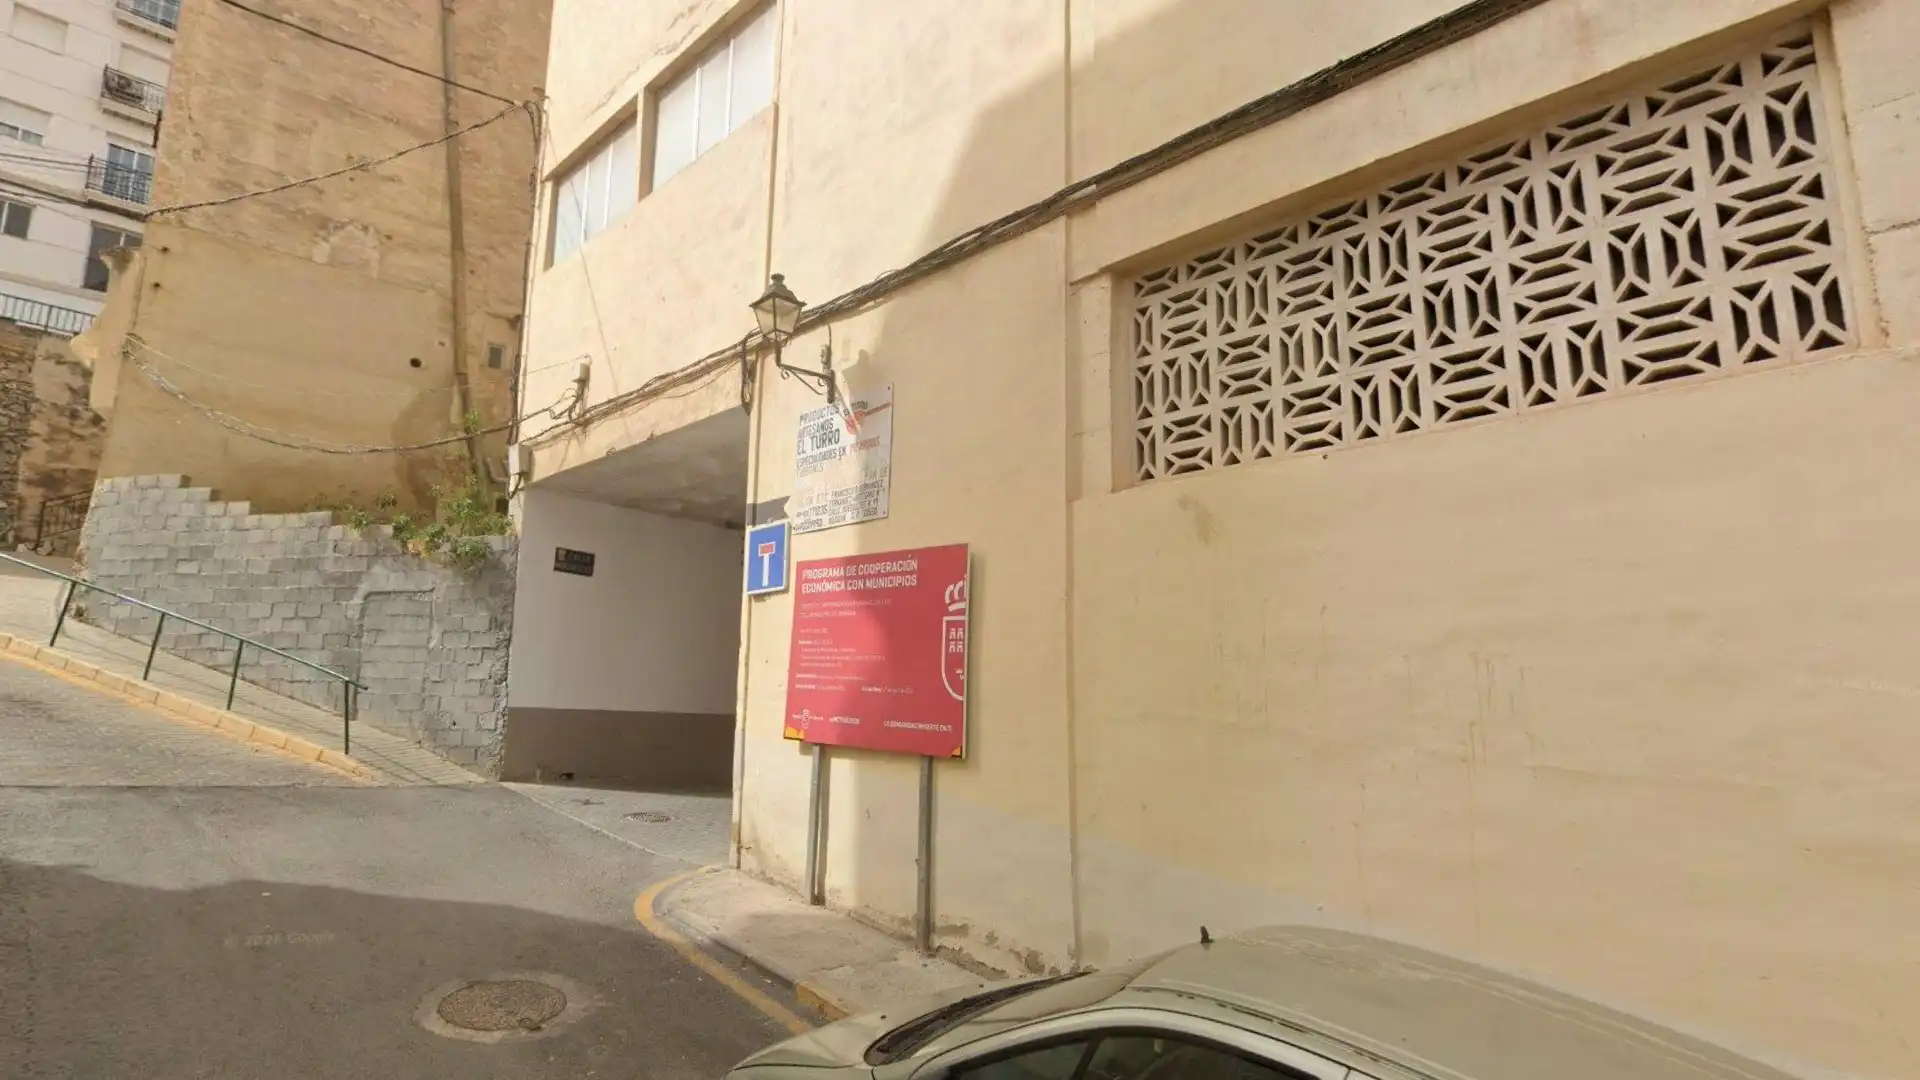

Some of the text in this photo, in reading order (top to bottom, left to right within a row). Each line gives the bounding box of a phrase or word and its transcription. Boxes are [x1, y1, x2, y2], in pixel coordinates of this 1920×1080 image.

[797, 438, 806, 455] EL
[810, 428, 840, 451] TURRO
[802, 553, 918, 580] PROGRAMA DE COOPERACIÓN
[801, 574, 917, 595] ECONÓMICA CON MUNICIPIOS
